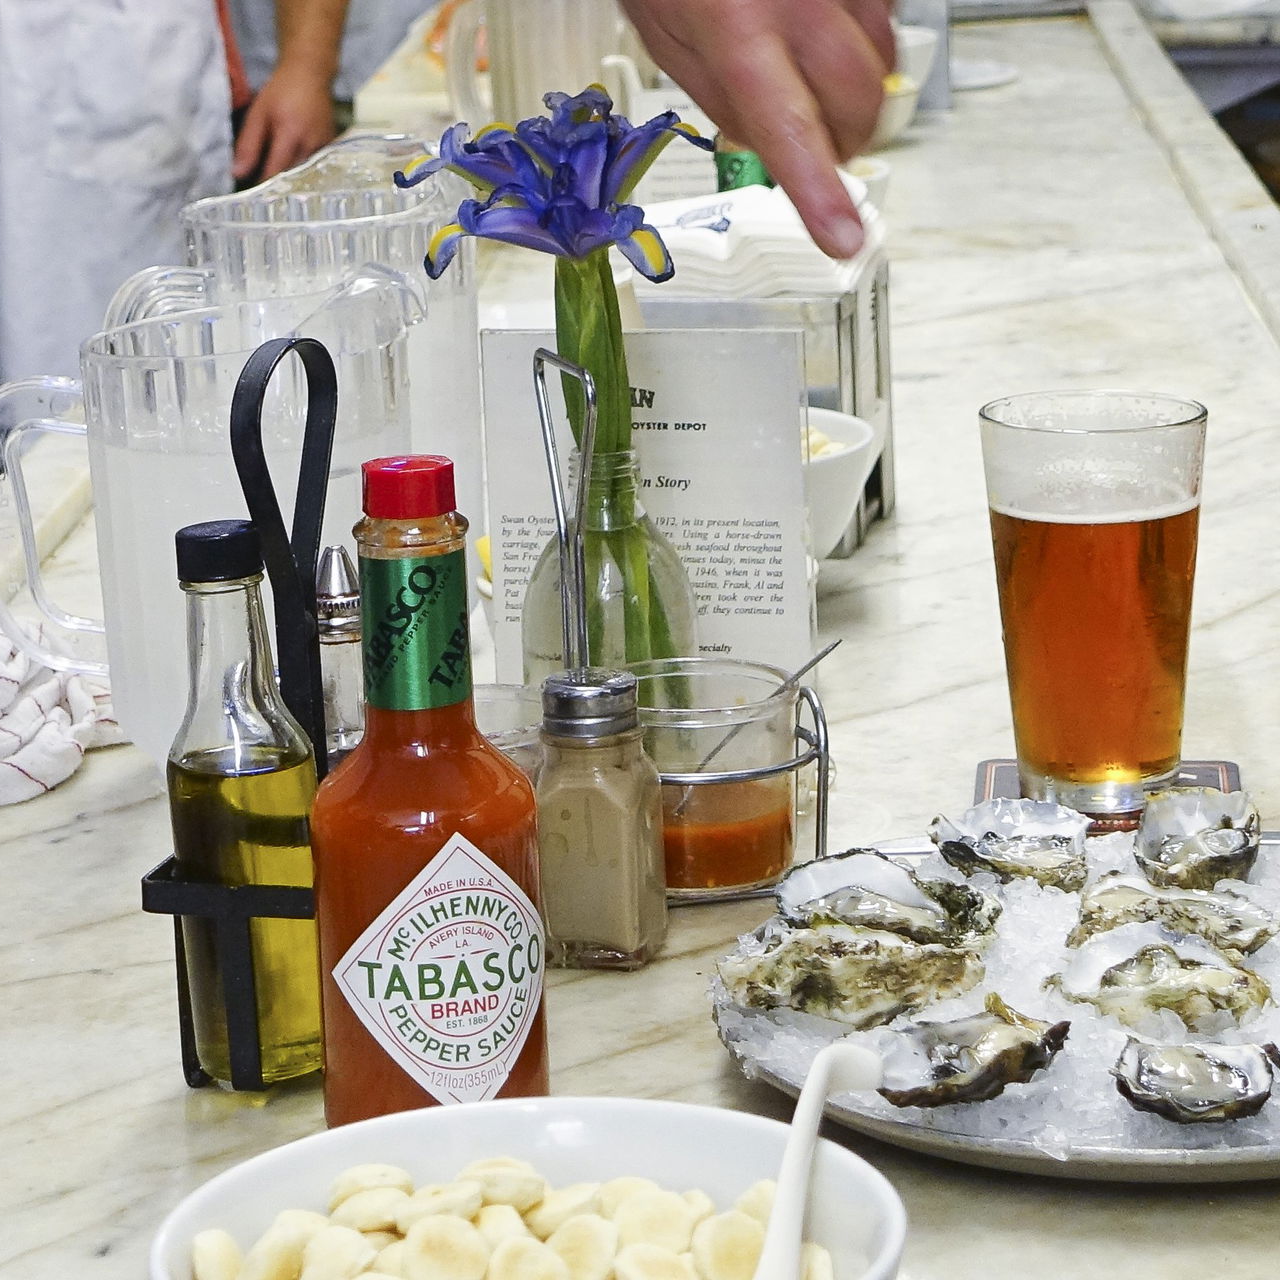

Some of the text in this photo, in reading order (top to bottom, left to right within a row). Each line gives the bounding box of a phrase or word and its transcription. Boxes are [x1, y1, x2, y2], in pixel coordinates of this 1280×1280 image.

[630, 422, 707, 432] OYSTER DEPOT
[655, 475, 692, 492] Story
[500, 515, 781, 528] Swan Oyster 1912, in its present location,
[501, 527, 513, 537] by
[517, 527, 531, 537] the
[682, 529, 709, 540] Using
[725, 531, 782, 540] horse-drawn
[502, 541, 541, 551] carriage,
[695, 543, 730, 554] seafood
[733, 544, 783, 554] throughout
[503, 551, 520, 561] San
[709, 555, 736, 566] today,
[739, 557, 766, 565] minus
[769, 557, 783, 565] the
[695, 567, 719, 578] 1946,
[724, 568, 748, 577] when
[754, 568, 761, 577] it
[766, 570, 784, 578] was
[690, 581, 720, 590] ousins,
[722, 580, 752, 591] Frank,
[754, 580, 765, 590] Al
[766, 581, 784, 590] and
[505, 589, 520, 598] Pat
[718, 591, 738, 601] took
[743, 593, 764, 602] over
[770, 592, 784, 602] the
[713, 605, 732, 616] they
[734, 606, 773, 615] continue
[775, 606, 785, 615] to
[505, 615, 521, 623] run
[399, 609, 431, 652] PEPPER
[423, 877, 495, 898] MADE IN U.S.A.
[429, 926, 495, 950] AVERY ISLAND
[455, 938, 472, 949] LA.
[357, 932, 541, 1002] TABASCO
[430, 993, 500, 1020] BRAND
[388, 985, 528, 1063] PEPPER SAUCE
[446, 1014, 489, 1030] EST. 1868
